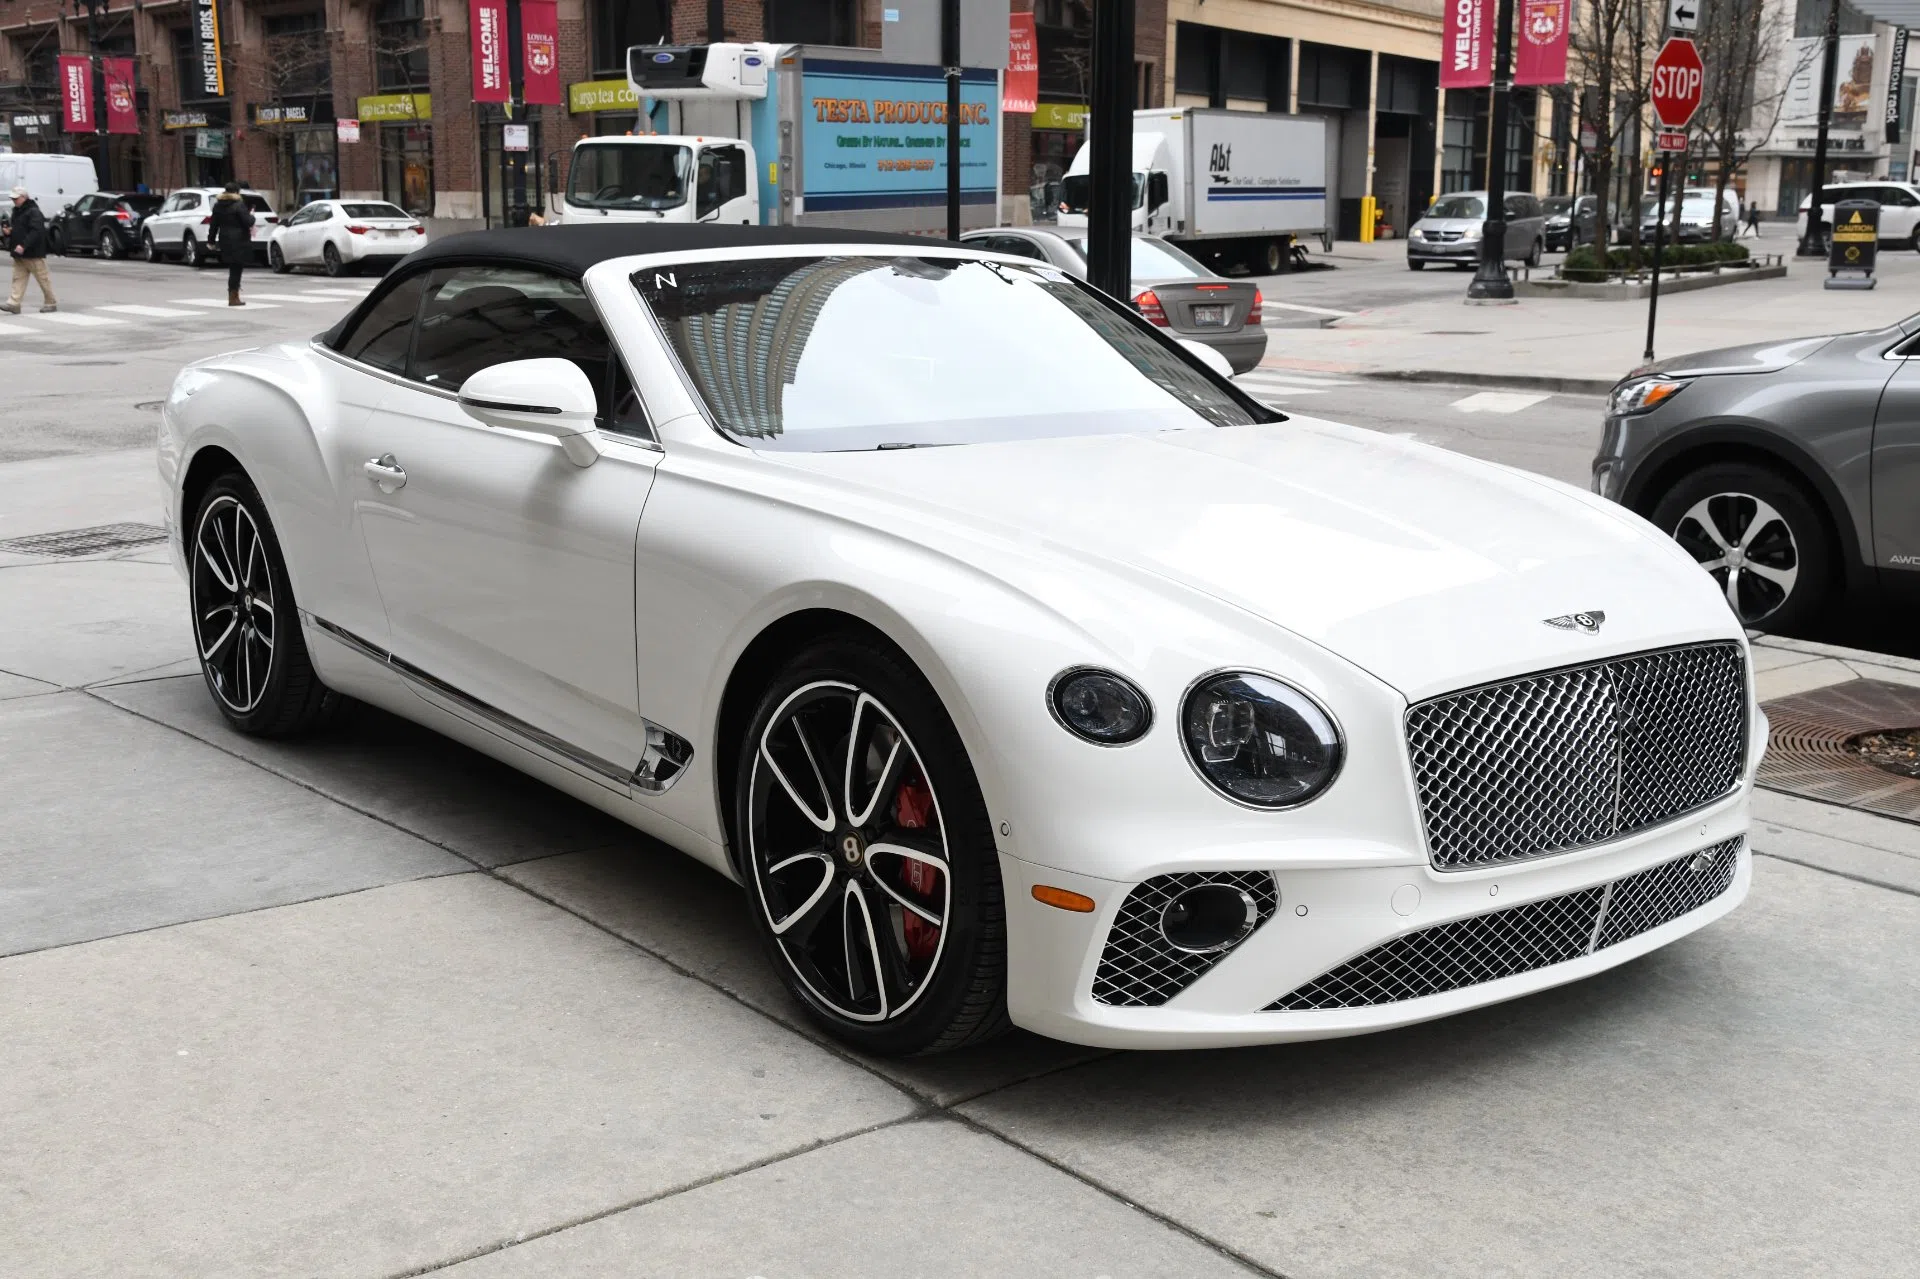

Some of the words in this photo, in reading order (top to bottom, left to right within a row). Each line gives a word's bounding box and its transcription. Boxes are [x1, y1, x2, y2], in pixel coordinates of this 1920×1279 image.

[200, 9, 215, 39] BROS.
[527, 33, 554, 42] LOYOLA
[1454, 0, 1472, 71] WELCO
[1472, 7, 1481, 39] TOWER
[479, 7, 494, 89] WELCOME
[1471, 41, 1480, 71] WATER
[1889, 29, 1906, 92] ORDSTROM
[202, 42, 219, 93] EINSTEIN
[1654, 65, 1700, 100] STOP
[67, 65, 82, 123] WELCOME
[598, 88, 614, 103] tea
[1886, 95, 1899, 123] rack
[813, 97, 871, 123] TESTA
[873, 100, 948, 124] PRODUCE
[959, 103, 990, 125] INC.
[1209, 143, 1232, 172] Abt
[1836, 224, 1874, 232] CAUTION
